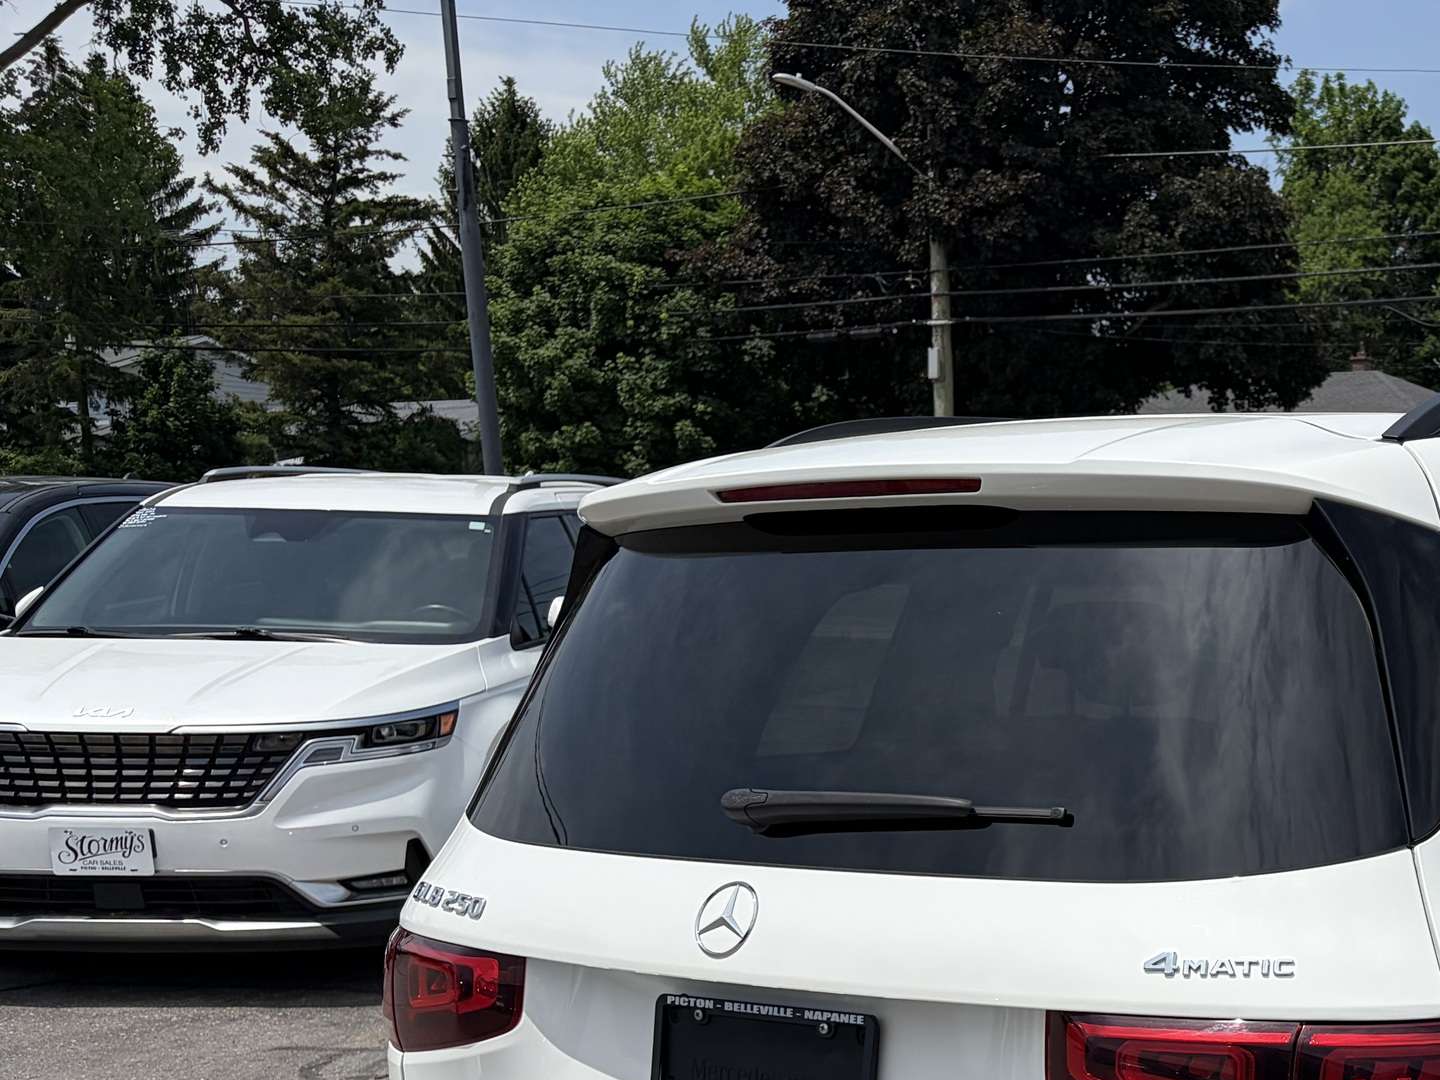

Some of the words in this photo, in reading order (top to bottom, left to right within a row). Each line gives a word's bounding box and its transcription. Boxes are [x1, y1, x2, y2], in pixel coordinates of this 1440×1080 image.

[57, 833, 145, 864] Stormy's
[441, 890, 487, 921] 250
[1143, 951, 1296, 979] 4MATIC
[666, 995, 714, 1009] PICTON
[724, 1001, 793, 1018] BELLEVILLE
[804, 1010, 865, 1025] NAPANEE
